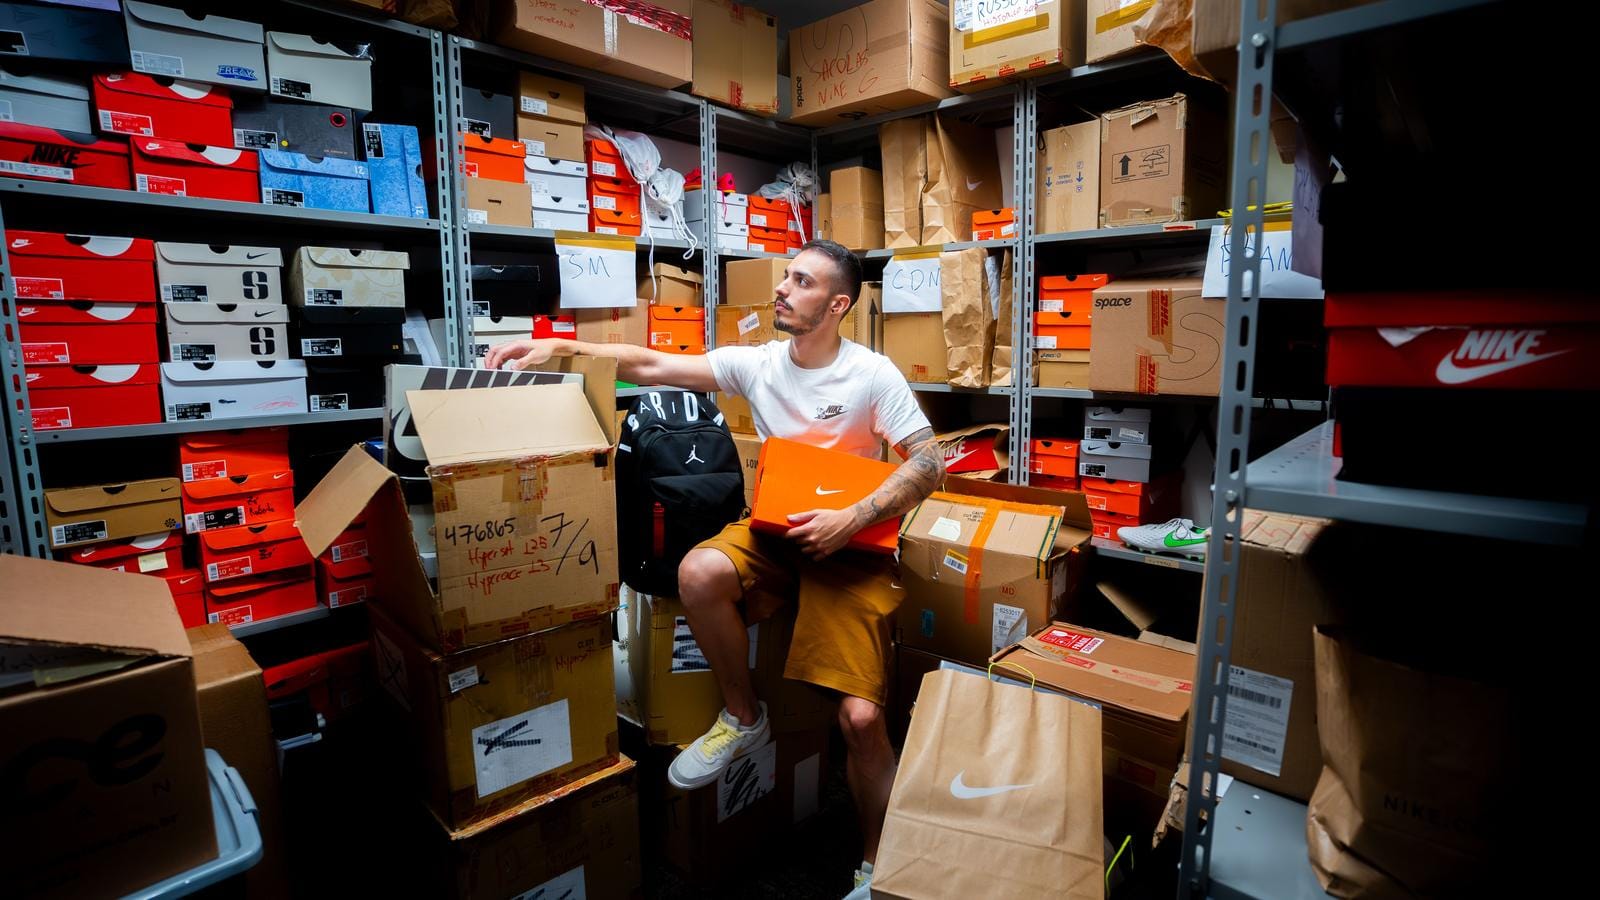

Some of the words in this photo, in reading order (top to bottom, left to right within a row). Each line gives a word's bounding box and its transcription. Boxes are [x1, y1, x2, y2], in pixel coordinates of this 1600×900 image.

[31, 144, 80, 164] NIKE
[1095, 297, 1133, 310] space
[1456, 330, 1547, 360] NIKE
[944, 440, 966, 458] IKE
[445, 517, 517, 546] 476865
